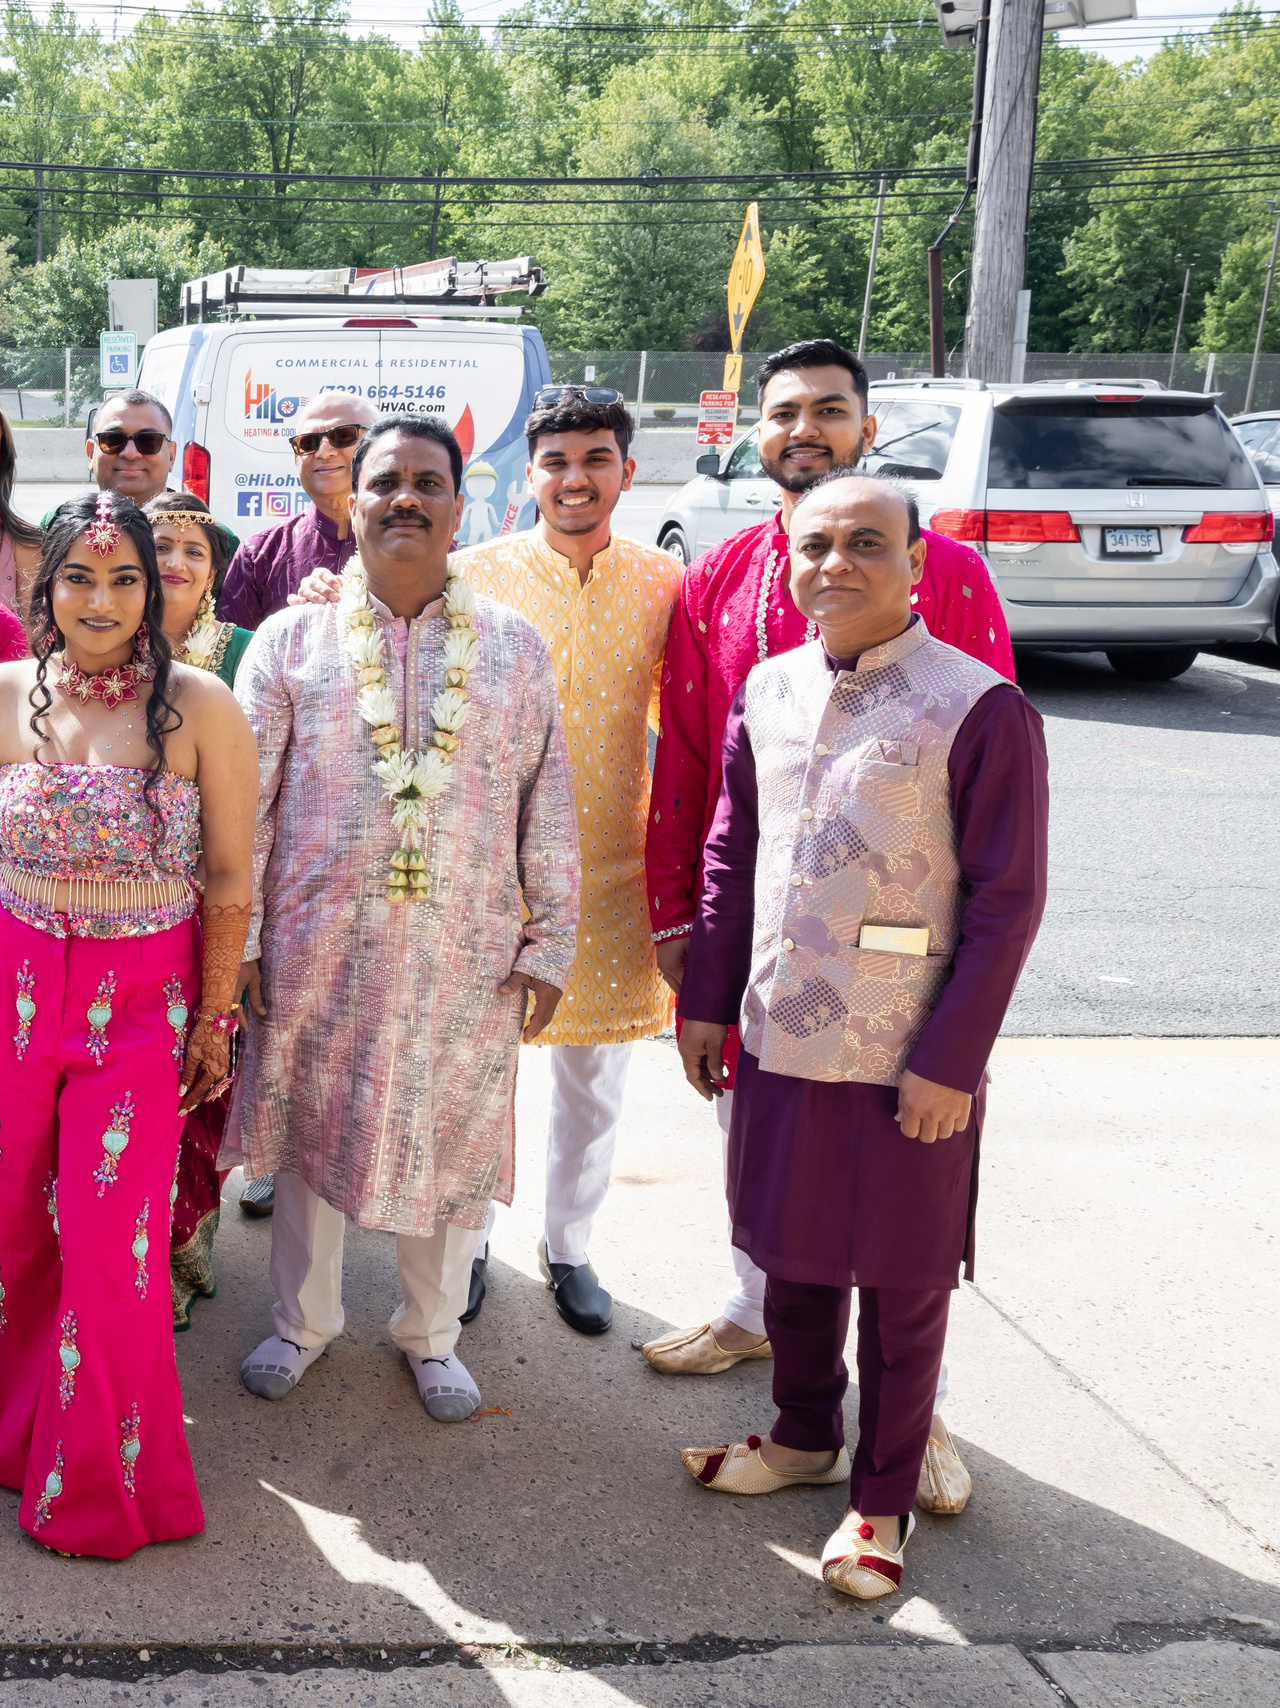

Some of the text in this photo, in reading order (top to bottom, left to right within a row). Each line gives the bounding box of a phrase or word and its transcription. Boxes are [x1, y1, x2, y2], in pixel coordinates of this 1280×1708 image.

[103, 335, 134, 344] RESERVED
[106, 345, 132, 353] PARKING
[275, 358, 479, 368] COMMERCIAL & RESIDENTIAL
[367, 385, 447, 398] 664-5146
[376, 402, 446, 413] HVAC.com
[243, 428, 272, 437] HEATING
[273, 428, 280, 437] &
